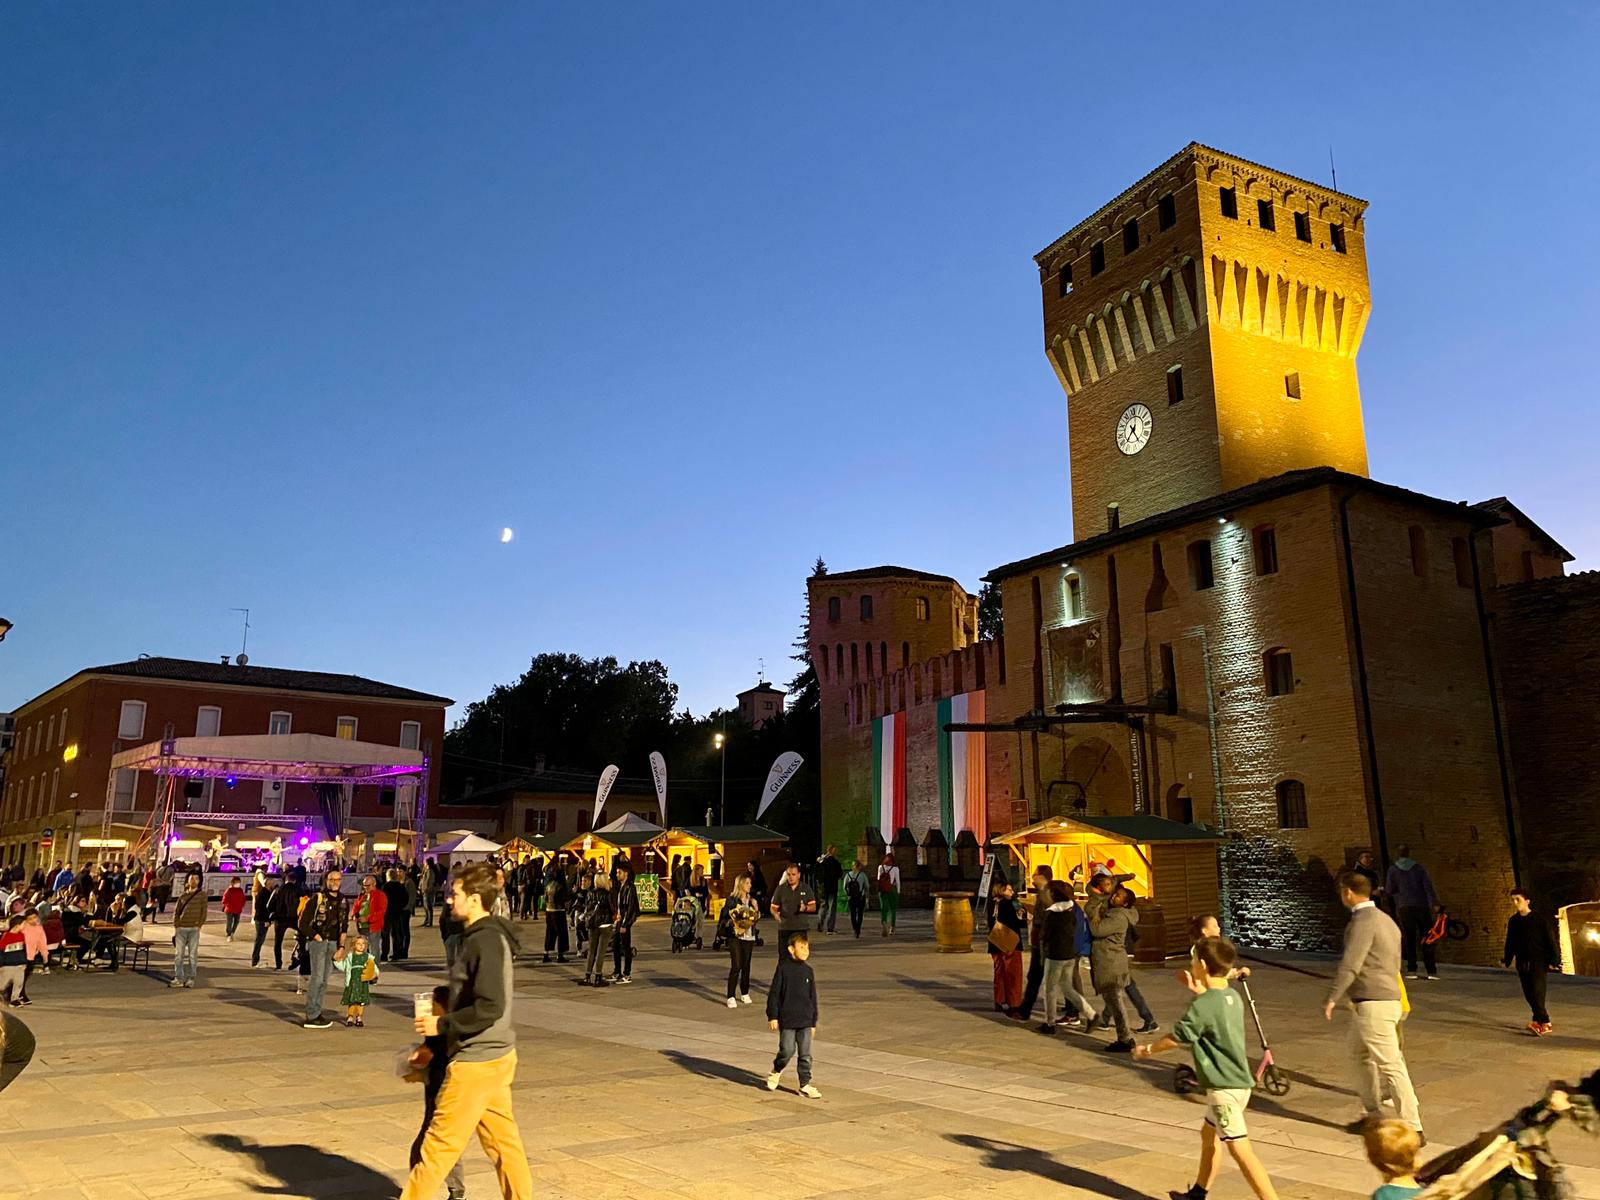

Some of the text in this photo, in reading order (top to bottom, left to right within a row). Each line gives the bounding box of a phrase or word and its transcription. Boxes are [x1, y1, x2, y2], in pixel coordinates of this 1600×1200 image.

[599, 770, 617, 803] GUINNESS
[770, 759, 800, 792] GUINNESS
[1132, 769, 1140, 782] del
